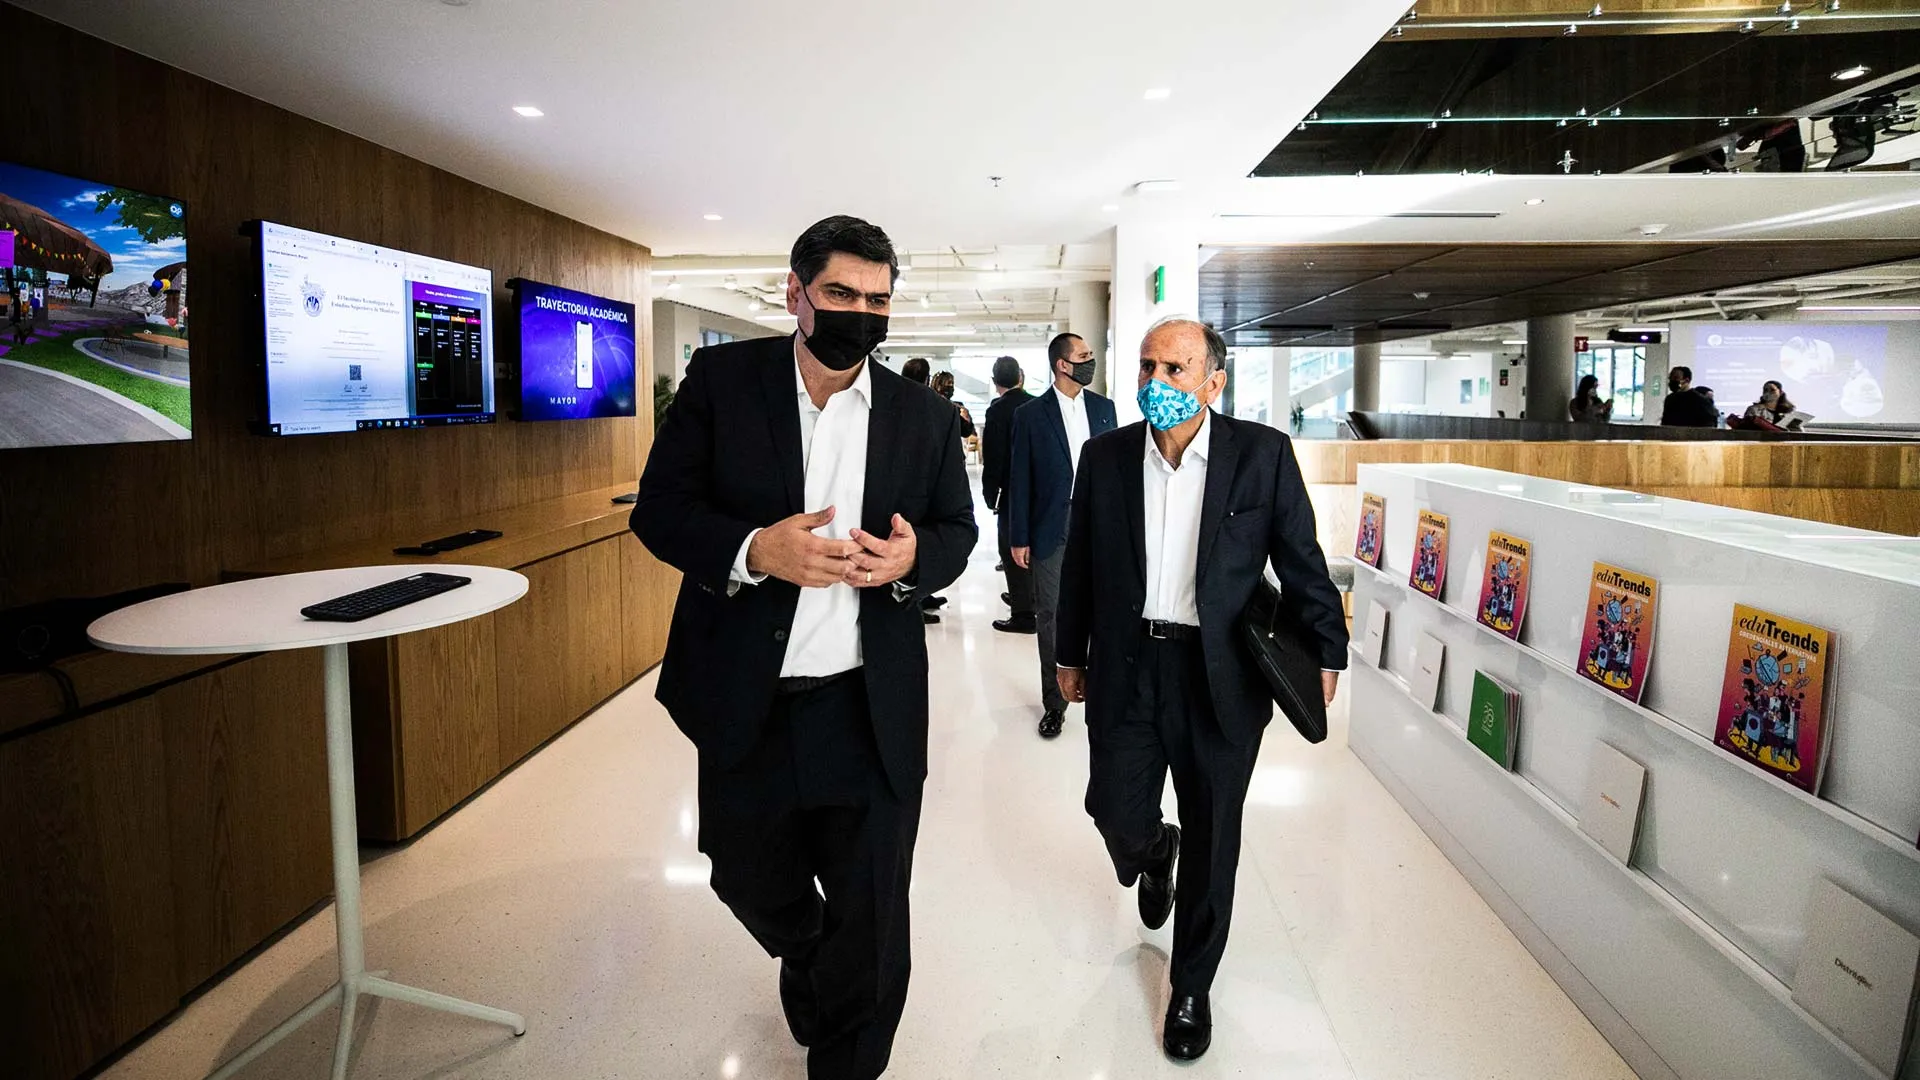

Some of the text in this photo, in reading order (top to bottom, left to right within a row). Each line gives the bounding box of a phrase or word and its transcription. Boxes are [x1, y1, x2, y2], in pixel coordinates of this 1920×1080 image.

[536, 295, 628, 324] TRAYECTORIA ACADÉMICA
[550, 396, 577, 405] MAYOR
[1491, 536, 1527, 556] eduTrends
[1596, 569, 1651, 597] eduTrends
[1739, 615, 1820, 654] eduTrends
